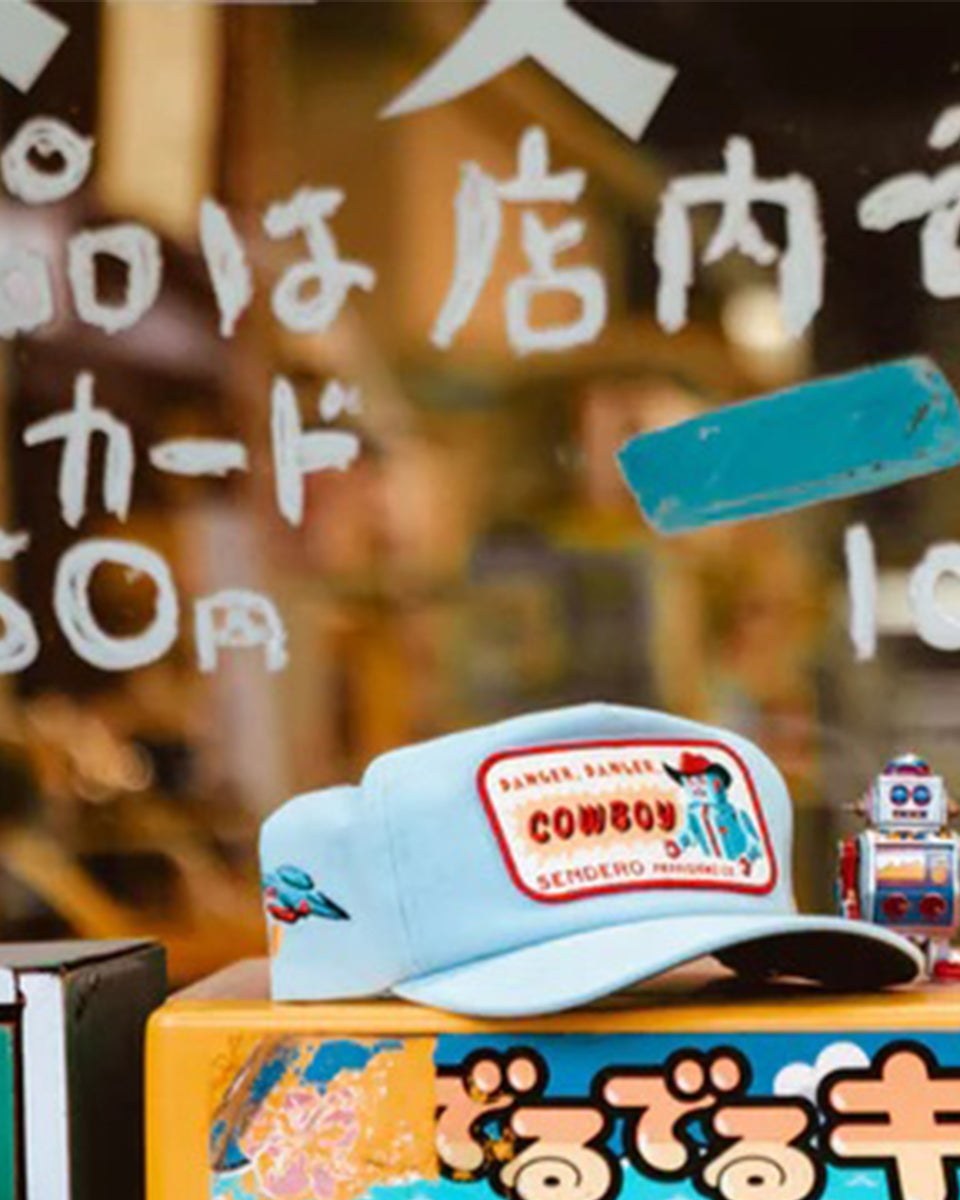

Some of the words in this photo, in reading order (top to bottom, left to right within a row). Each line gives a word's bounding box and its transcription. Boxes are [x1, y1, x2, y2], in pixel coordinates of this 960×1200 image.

[22, 371, 364, 528] カード
[528, 799, 677, 844] COWBOY
